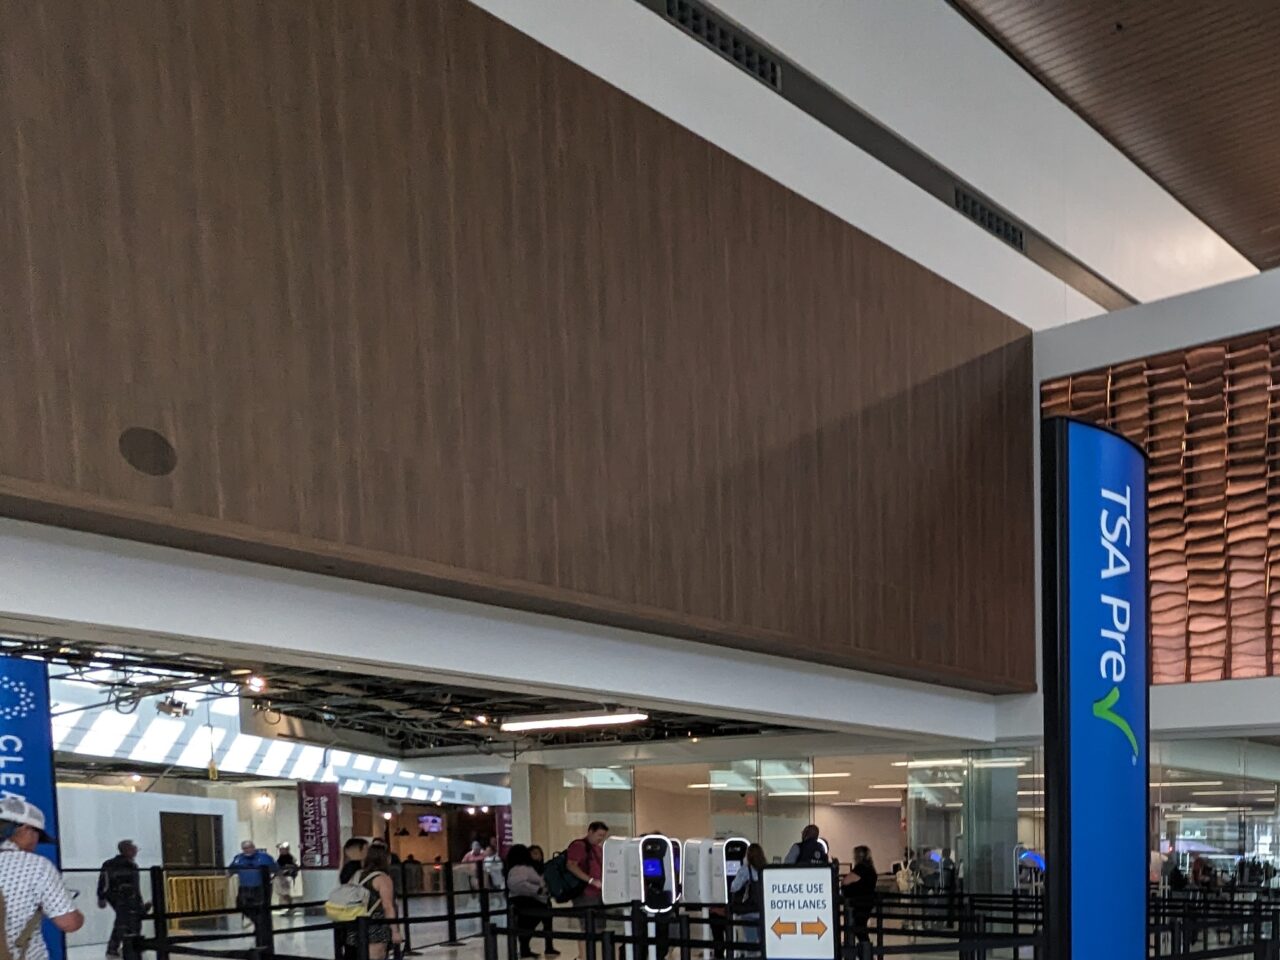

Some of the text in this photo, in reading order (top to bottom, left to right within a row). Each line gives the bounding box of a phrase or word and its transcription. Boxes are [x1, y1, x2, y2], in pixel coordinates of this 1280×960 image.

[1100, 485, 1131, 683] TSA Pre
[303, 796, 317, 854] MEHARRY
[770, 899, 827, 910] BOTH LANES
[771, 883, 824, 894] PLEASE USE
